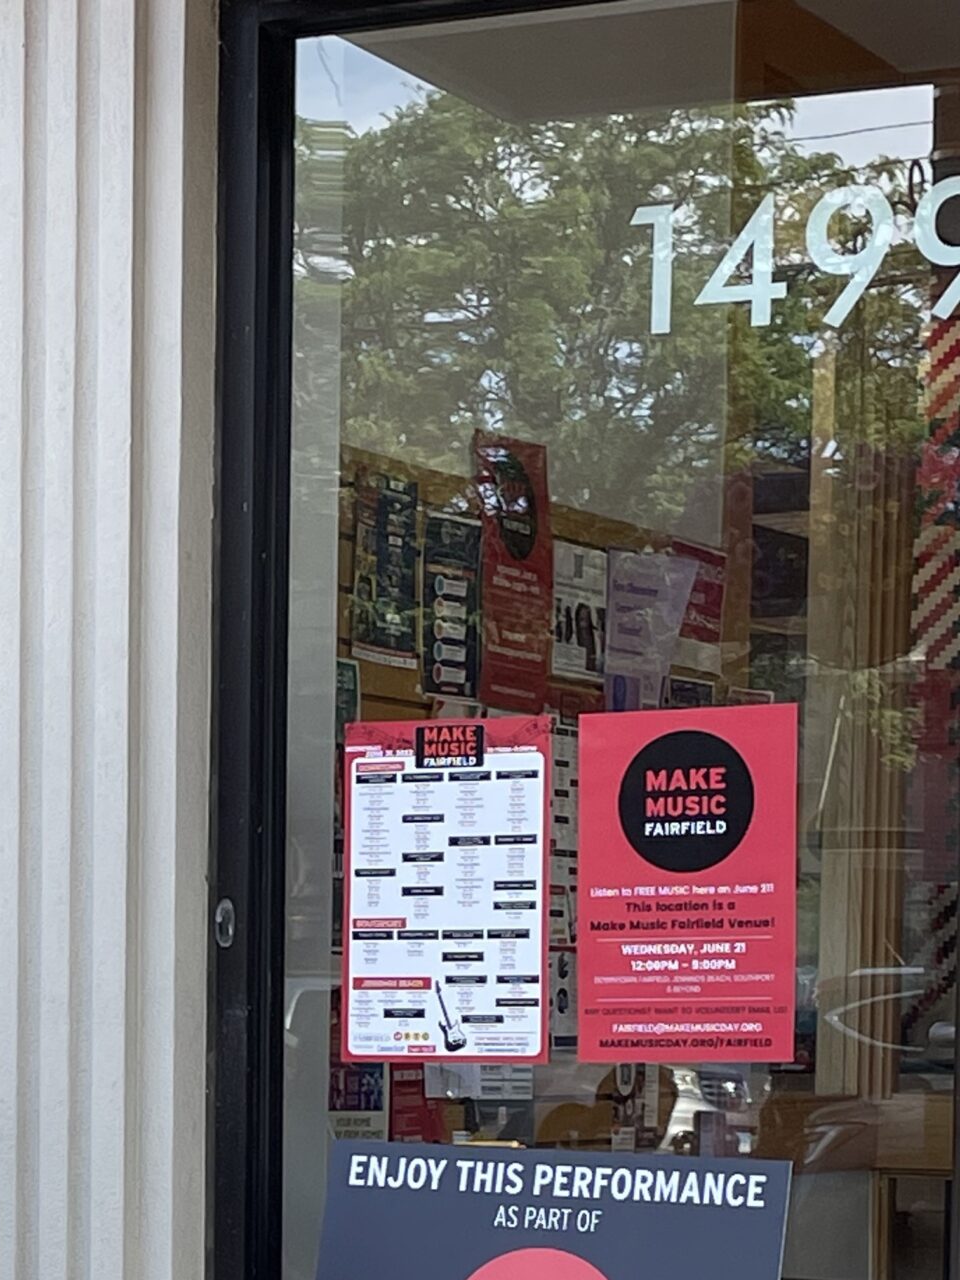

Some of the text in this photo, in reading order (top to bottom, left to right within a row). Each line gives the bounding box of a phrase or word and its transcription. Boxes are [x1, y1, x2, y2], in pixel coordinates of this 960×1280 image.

[424, 727, 477, 742] MAKE
[424, 743, 477, 756] MUSIC
[423, 756, 477, 767] FAIRFIELD
[646, 767, 726, 792] MAKE
[645, 794, 726, 817] MUSIC
[644, 820, 727, 836] FAIRFIELD
[590, 887, 619, 897] Listen
[621, 888, 632, 896] to
[634, 886, 656, 896] FREE
[658, 885, 689, 895] MUSIC
[692, 885, 715, 895] here
[717, 886, 730, 894] on
[733, 884, 758, 894] June
[626, 900, 735, 912] This location is a
[590, 917, 775, 931] Make Music Fairfield Venue!
[621, 942, 746, 955] WEDNESDAY, JUNE 21
[612, 1023, 763, 1034] FAIRFIELD@MAKEMUSICDAY.ORG
[599, 1037, 772, 1049] MAKEMUSICDAY.ORG/FAIRFIELD
[348, 1155, 767, 1207] ENJOY THIS PERFORMANCE
[494, 1205, 602, 1232] AS PART OF
